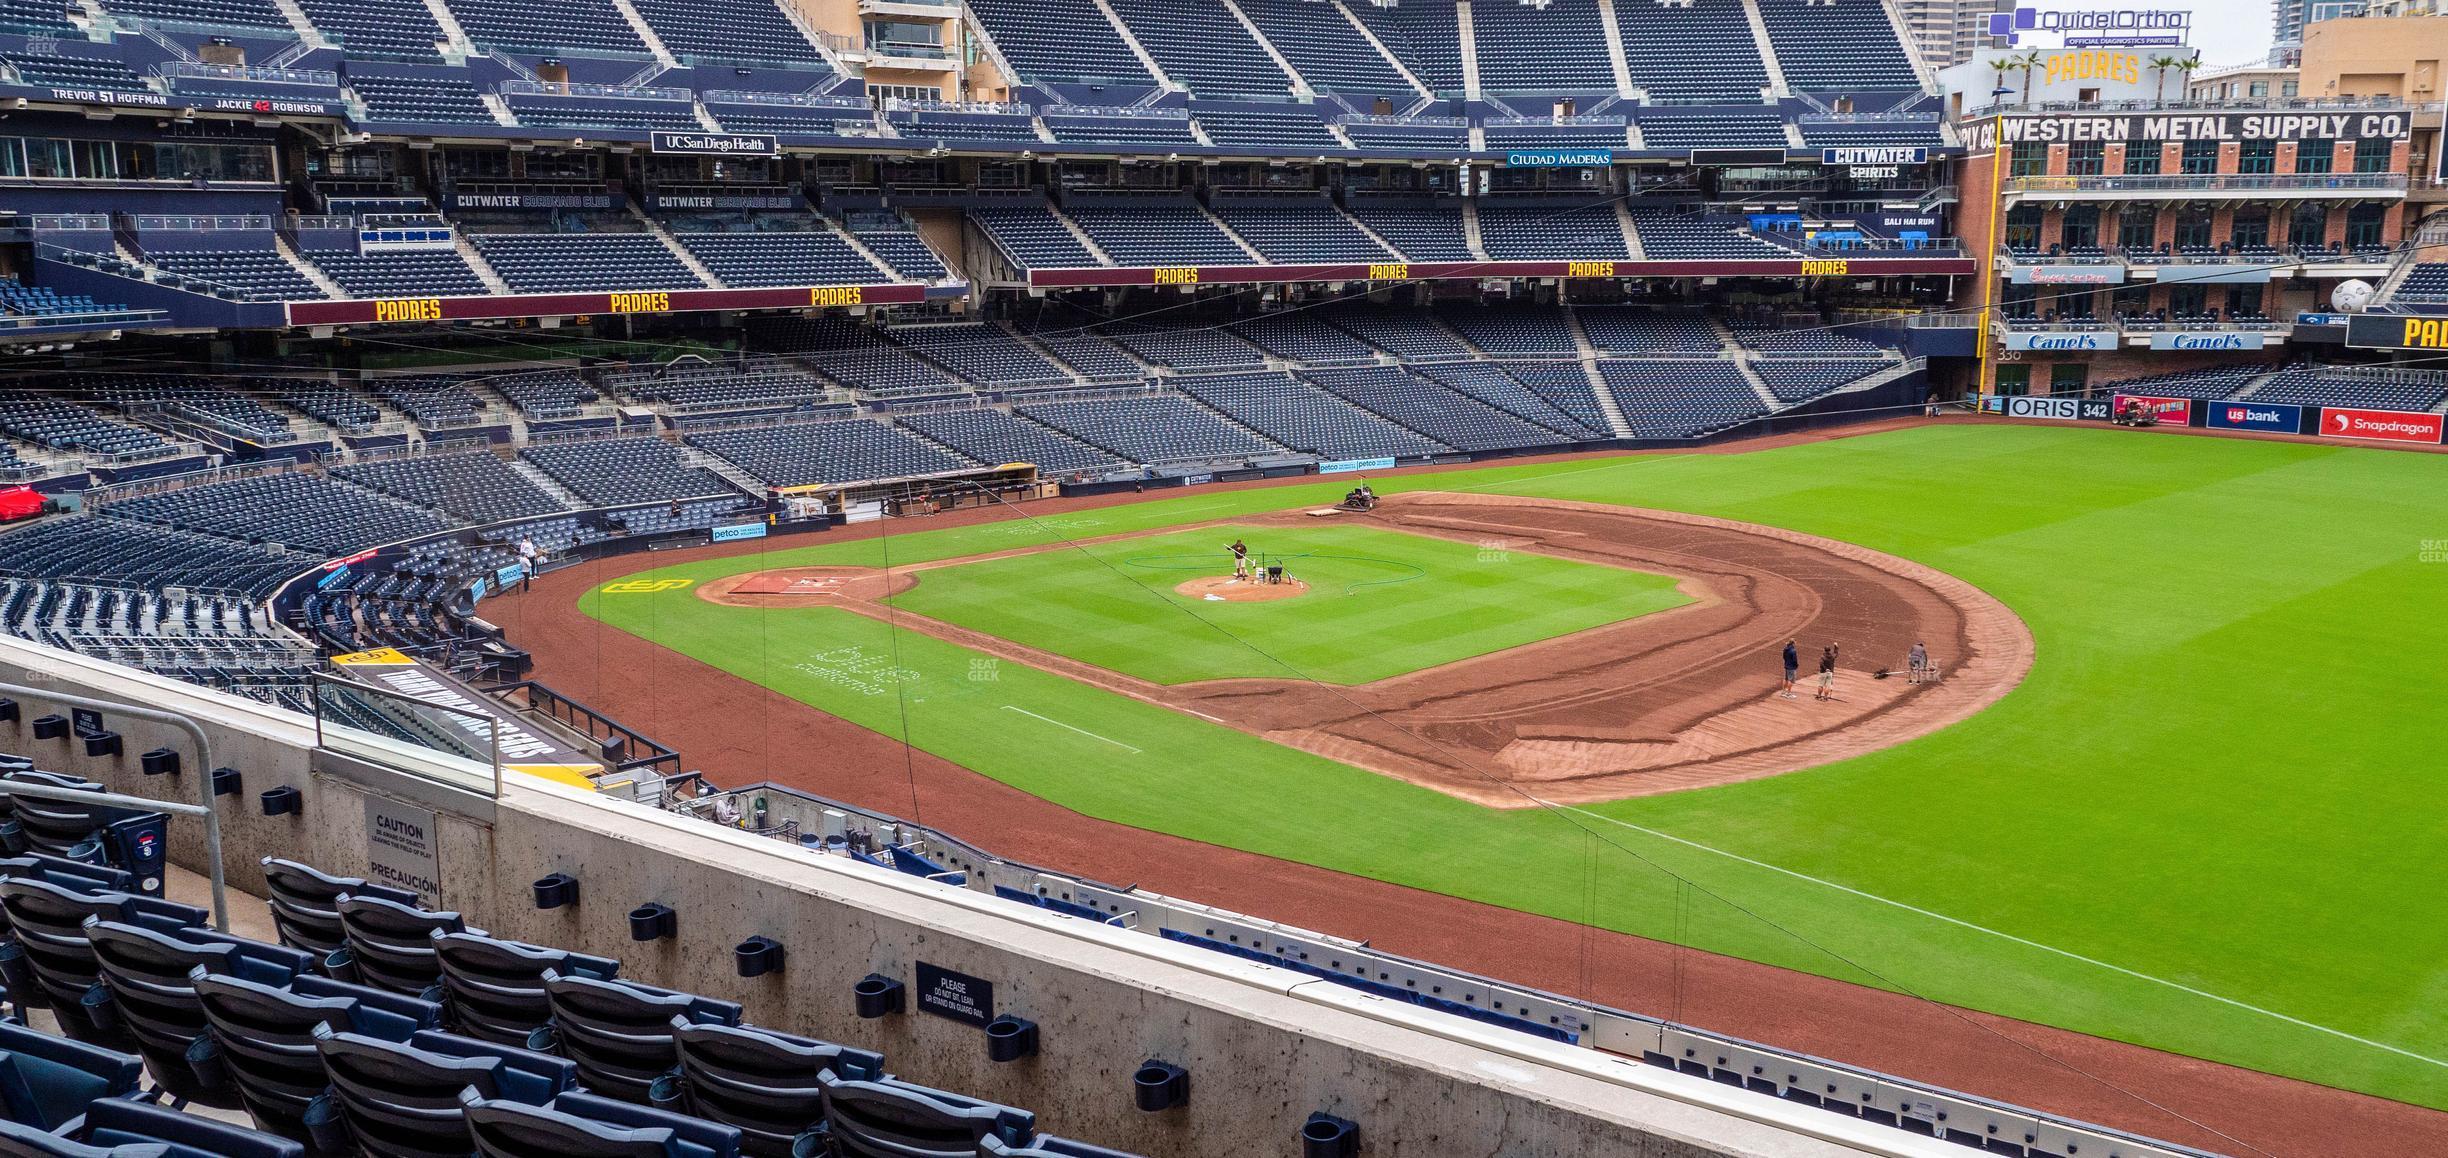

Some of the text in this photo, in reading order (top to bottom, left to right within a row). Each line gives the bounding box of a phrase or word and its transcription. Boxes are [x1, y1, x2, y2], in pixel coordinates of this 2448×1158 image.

[2042, 10, 2182, 33] QuidelOrtho
[2045, 50, 2140, 86] PADRES
[51, 89, 167, 105] TREVOR 51 HOFFMAN
[215, 100, 324, 114] JACKIE 42 ROBINSON
[2002, 114, 2408, 141] WESTERN METAL SUPPLY CO.
[665, 135, 765, 152] UC San Diego Health
[1510, 154, 1610, 165] CIUDAD MADERAS
[1835, 148, 1916, 163] CUTWATER
[1849, 167, 1899, 178] SPIRITS
[457, 195, 611, 208] CUTWATER CORONADO CLUB
[659, 197, 713, 208] CUTWATER
[1884, 218, 1935, 226] BALI HAI RUM
[1154, 268, 1198, 284] PADRES
[1369, 264, 1408, 280] PADRES
[1569, 262, 1614, 276] PADRES
[1802, 261, 1847, 275] PADRES
[610, 293, 670, 313] PADRES
[811, 287, 861, 306] PADRES
[376, 299, 441, 322] PADRES
[2028, 334, 2097, 350] Canel's
[2171, 333, 2242, 350] Canel's
[2012, 398, 2076, 418] ORIS
[2083, 403, 2107, 418] 342
[2228, 409, 2280, 423] us bank
[2354, 418, 2433, 436] Snapdragon
[715, 530, 740, 540] petco
[376, 814, 423, 840] CAUTION
[372, 835, 390, 846] LEAVING
[391, 841, 400, 849] THE
[400, 844, 412, 853] FIELD
[420, 850, 432, 859] PLAY
[406, 838, 426, 850] OBJECTS
[371, 861, 438, 895] PRECAUCIÓN
[941, 977, 966, 994] PLEASE
[935, 987, 941, 996] DO
[942, 990, 951, 999] NOT
[961, 995, 974, 1006] LEAN
[925, 994, 984, 1019] OR STAND ON GUARD RAIL
